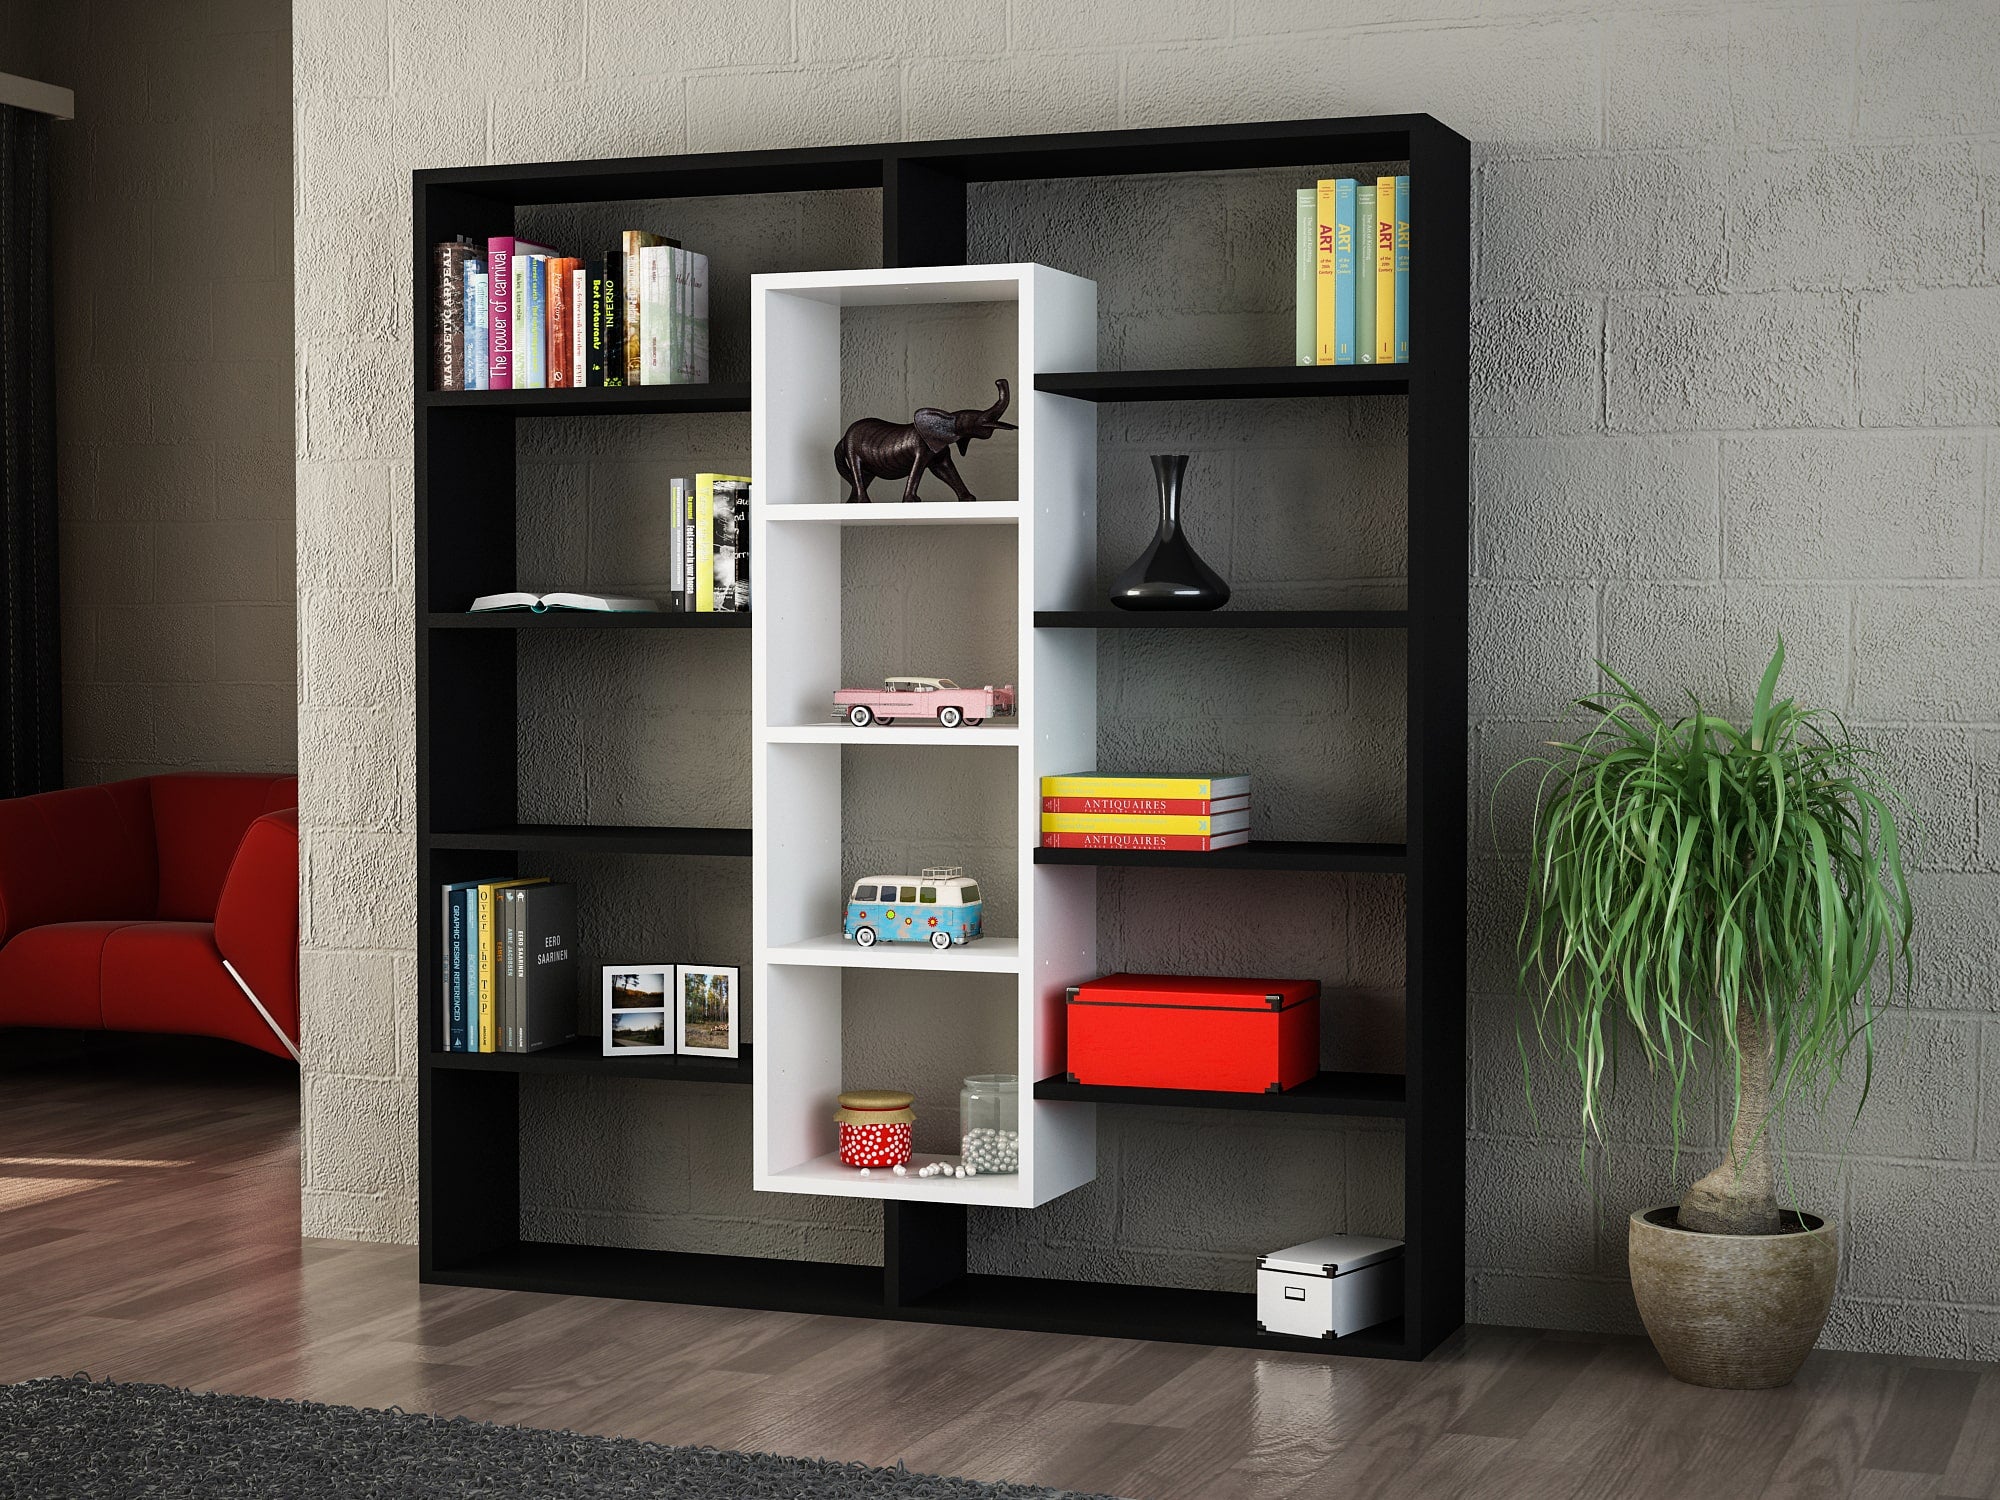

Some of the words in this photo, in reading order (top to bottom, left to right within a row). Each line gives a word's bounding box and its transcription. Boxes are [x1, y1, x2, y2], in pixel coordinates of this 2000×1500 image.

[1320, 225, 1332, 253] ART
[1338, 224, 1351, 253] ART
[1380, 222, 1392, 251] ART
[443, 248, 452, 308] APPEAL
[490, 250, 507, 296] carnival
[552, 272, 563, 299] Perfect
[593, 280, 601, 298] Best
[490, 298, 507, 313] of
[552, 302, 564, 322] Story
[606, 280, 614, 328] INFERNO
[494, 316, 512, 352] power
[593, 300, 601, 350] restaurants
[443, 310, 452, 386] MAGNETIC
[490, 356, 507, 378] The
[1084, 799, 1166, 810] ANTIQUAIRES
[1084, 835, 1166, 846] ANTIQUAIRES
[480, 891, 488, 930] Over
[545, 935, 561, 948] EERO
[480, 942, 488, 970] the
[537, 949, 568, 965] SAARINEN
[480, 980, 488, 1013] Top
